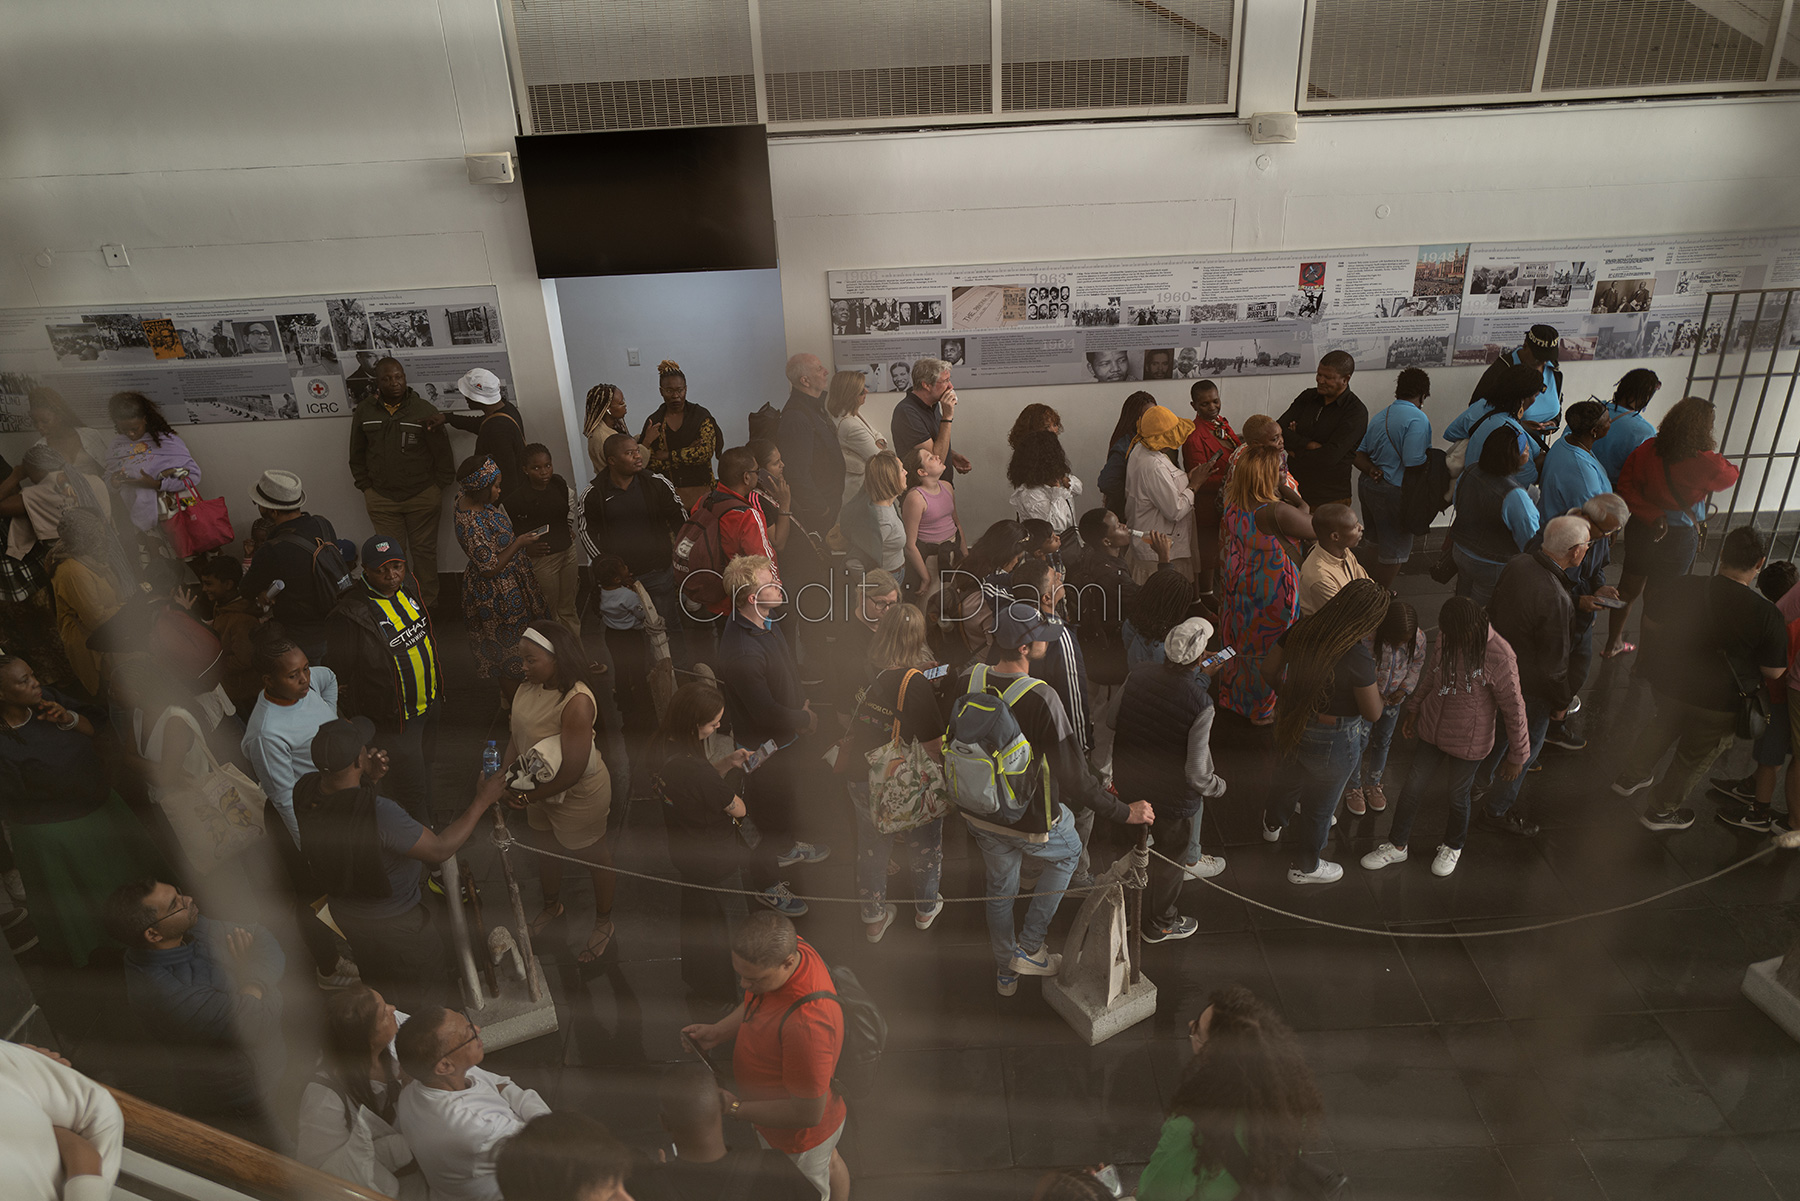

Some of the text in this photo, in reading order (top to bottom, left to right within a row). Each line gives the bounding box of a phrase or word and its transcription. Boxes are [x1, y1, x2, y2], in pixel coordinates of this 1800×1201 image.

[1422, 252, 1456, 263] 1948
[845, 271, 878, 281] 1966
[1032, 273, 1067, 285] 1963
[1156, 291, 1191, 303] 1960
[1041, 338, 1075, 350] 1964
[306, 402, 339, 414] ICRC
